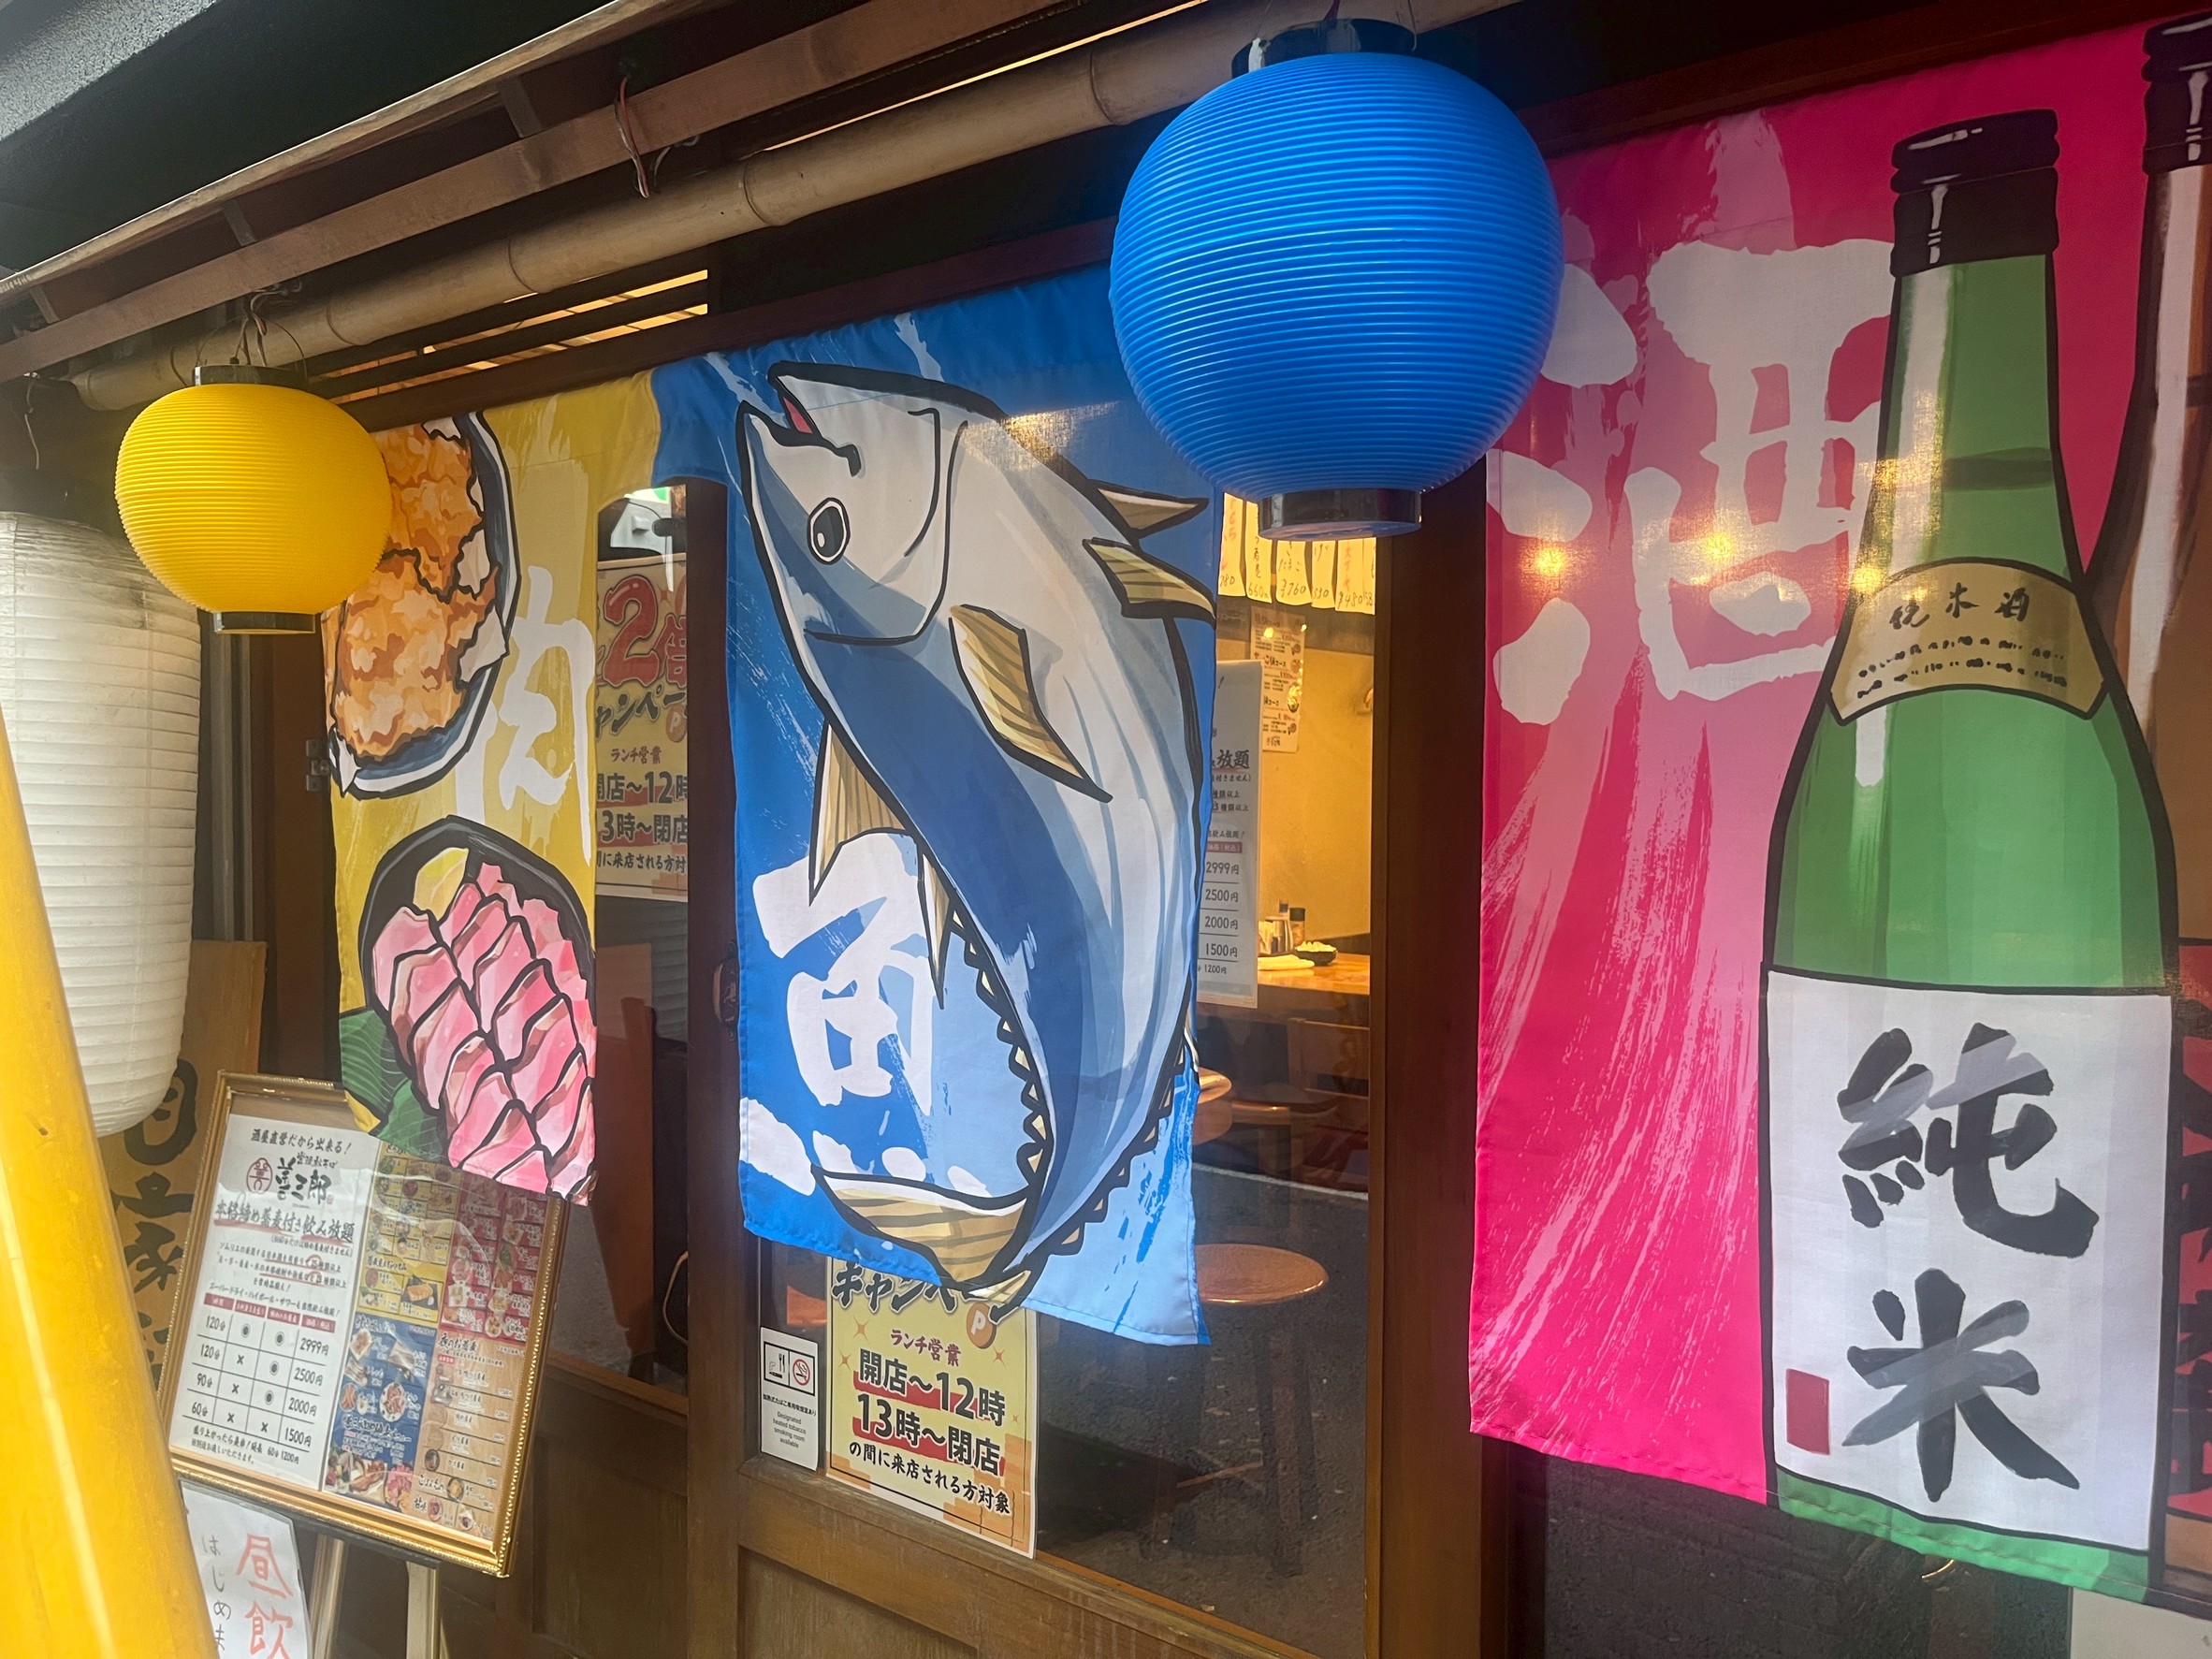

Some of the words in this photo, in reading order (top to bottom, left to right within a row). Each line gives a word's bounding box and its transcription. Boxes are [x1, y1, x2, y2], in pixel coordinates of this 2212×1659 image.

[1483, 239, 1901, 725] 酒
[597, 575, 687, 689] 2倍
[611, 746, 662, 764] ランチ営業
[1212, 749, 1249, 768] 放題
[1205, 861, 1240, 876] 2999円
[1205, 888, 1239, 903] 2500円
[1204, 915, 1239, 930] 2000円
[1205, 942, 1238, 958] 1500円
[1203, 964, 1228, 975] 1200円
[1837, 1022, 2101, 1504] 純米
[832, 1260, 1022, 1324] キャンペ
[206, 1315, 226, 1332] 120分
[200, 1344, 220, 1361] 120分
[299, 1337, 329, 1356] 2999円
[891, 1329, 962, 1367] ランチ営業
[196, 1373, 212, 1389] 90分
[294, 1367, 324, 1387] 2500円
[859, 1347, 1006, 1427] 開店～12時
[192, 1402, 208, 1418] 60分
[288, 1397, 317, 1417] 2000円
[284, 1427, 312, 1448] 1500円
[857, 1393, 1001, 1477] 13時～閉店
[849, 1441, 1011, 1514] の間に来店される方対象
